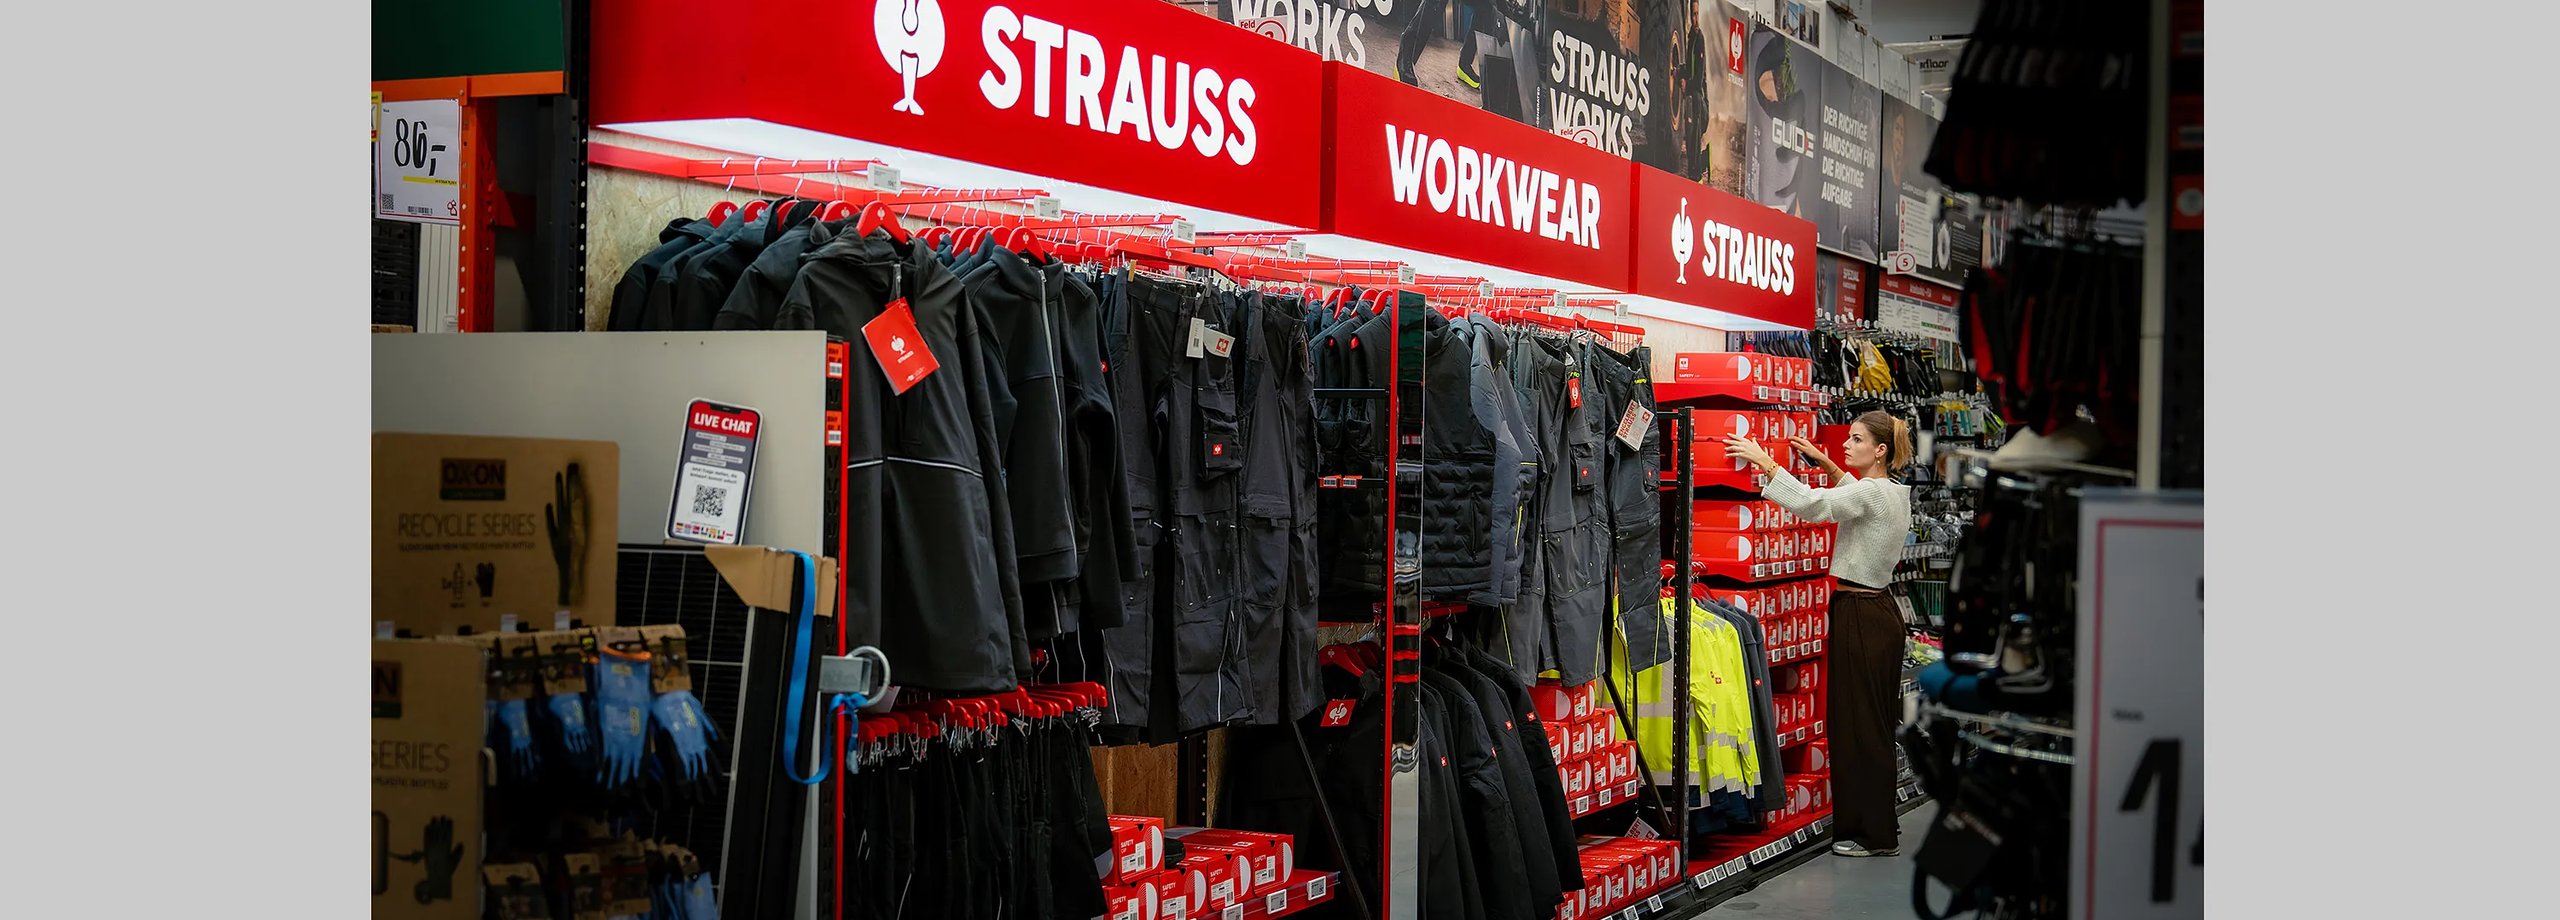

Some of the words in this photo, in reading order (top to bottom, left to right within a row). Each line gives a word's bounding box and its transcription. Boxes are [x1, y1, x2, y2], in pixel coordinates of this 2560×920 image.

[1240, 20, 1256, 28] Feld
[979, 5, 1257, 166] STRAUSS
[1551, 30, 1650, 116] STRAUSS
[1727, 73, 1744, 88] STRAUSS
[1550, 87, 1633, 160] WORKS
[1824, 105, 1838, 128] DER
[1839, 110, 1868, 142] RICHTIGE
[1772, 117, 1815, 159] GUIDE
[1823, 130, 1862, 165] HANDSCHUH
[1863, 147, 1876, 170] FÜR
[1822, 155, 1834, 178] DIE
[1835, 160, 1864, 189] RICHTIGE
[1385, 123, 1601, 250] WORKWEAR
[1821, 181, 1853, 209] AUFGABE
[1702, 219, 1795, 296] STRAUSS
[694, 412, 720, 428] LIVE
[721, 417, 753, 434] CHAT
[398, 513, 478, 537] RECYCLE
[481, 513, 537, 537] SERIES
[1120, 838, 1134, 848] SAFETY
[1210, 868, 1223, 877] SAFETY
[1254, 854, 1267, 863] SAFETY
[1112, 895, 1127, 905] SAFETY
[1162, 882, 1176, 892] SAFETY
